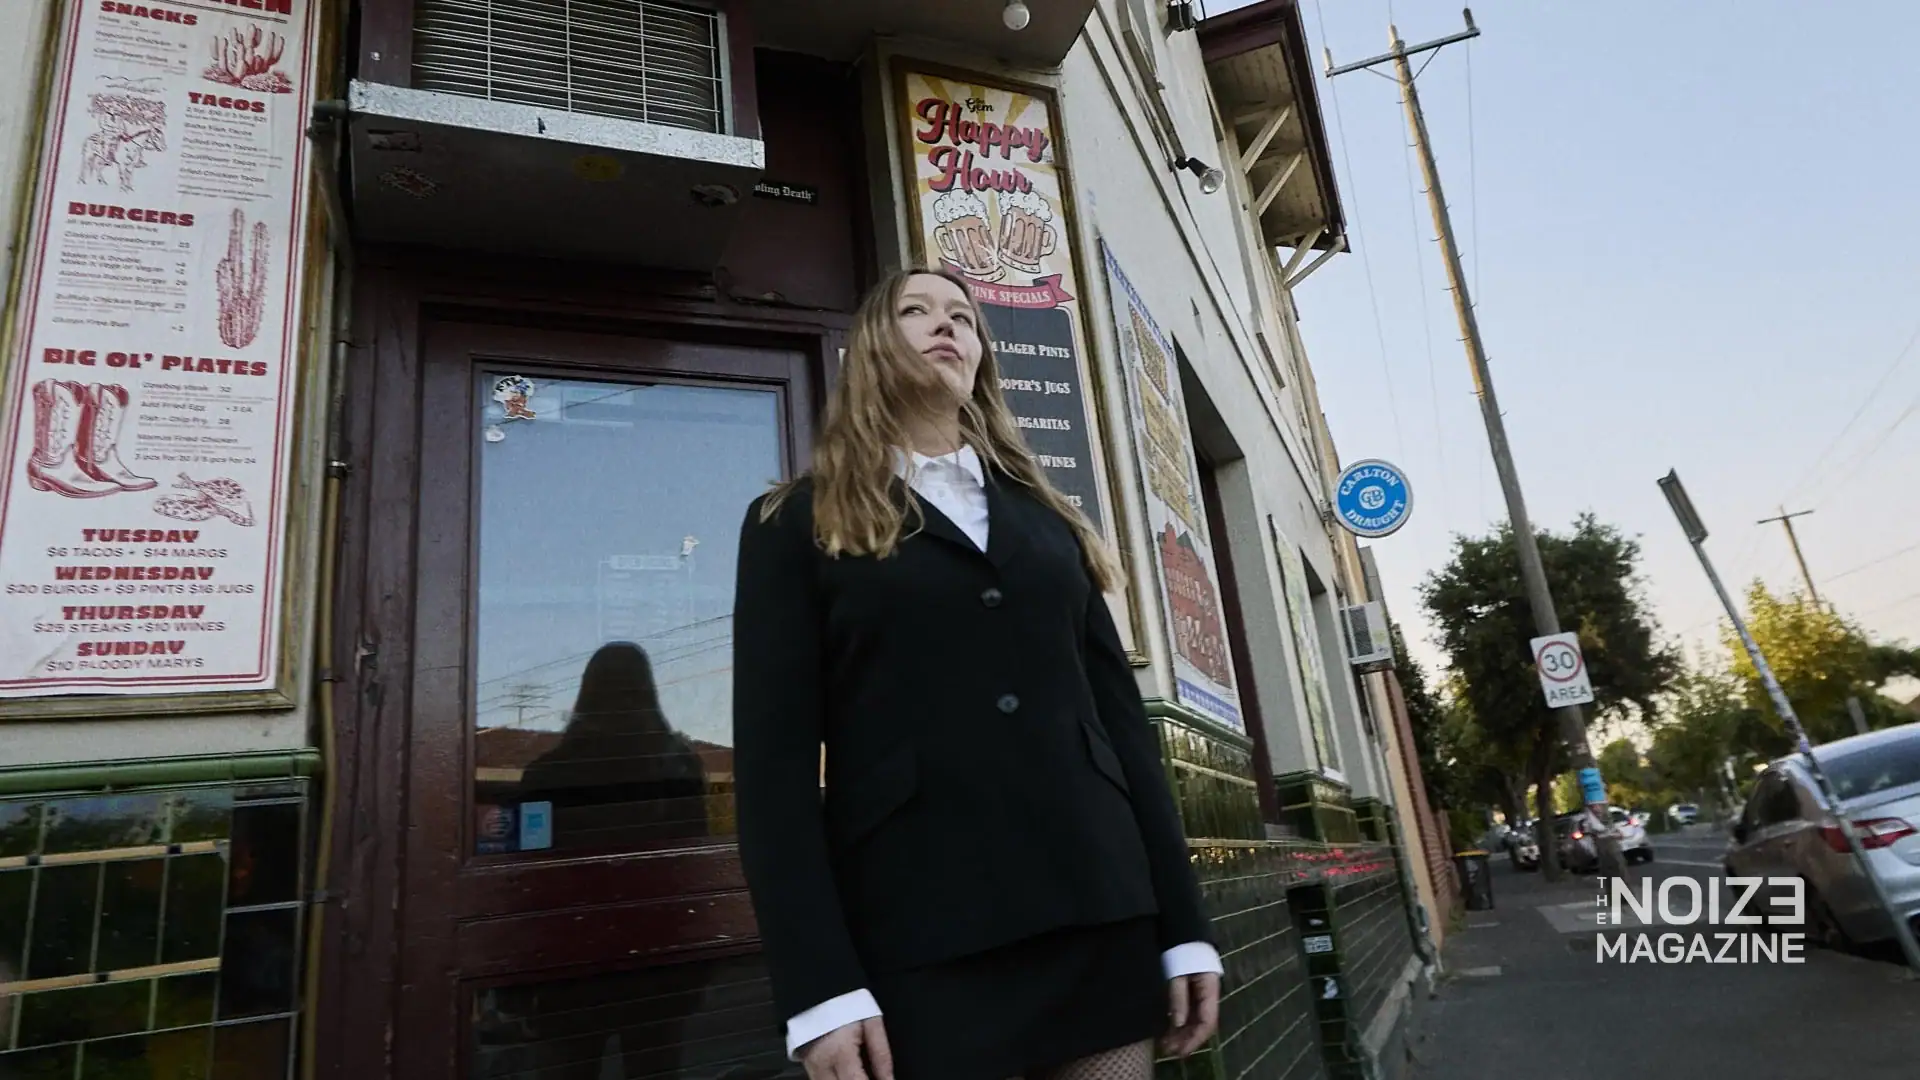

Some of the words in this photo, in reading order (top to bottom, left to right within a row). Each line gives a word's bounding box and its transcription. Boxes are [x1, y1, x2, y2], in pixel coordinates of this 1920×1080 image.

[101, 1, 197, 25] SNACKS
[187, 92, 266, 113] TACOS
[965, 97, 994, 113] Gem
[916, 98, 1049, 163] Happy
[928, 145, 1032, 194] Hour
[68, 201, 195, 227] BURGERS
[999, 290, 1051, 304] SPECIALS
[1000, 341, 1036, 355] LAGER
[1038, 344, 1071, 359] PINTS
[43, 348, 97, 367] BIG
[161, 355, 268, 377] PLATES
[1044, 380, 1071, 395] JUGS
[1039, 455, 1077, 468] WINES
[1340, 468, 1399, 496] CARLTON
[1345, 499, 1404, 527] DRAUGHT
[82, 528, 199, 543] TUESDAY
[72, 547, 124, 557] TACOS
[171, 548, 228, 558] MARGS
[55, 566, 215, 580] WEDNESDAY
[5, 584, 38, 594] $20
[42, 584, 99, 594] BURGS
[139, 584, 184, 594] PINTS
[216, 584, 255, 594] JUGS
[62, 605, 205, 620] THURSDAY
[69, 622, 132, 632] STEAKS
[175, 621, 226, 632] WINES
[76, 640, 186, 656] SUNDAY
[147, 657, 205, 668] MARYS
[1544, 651, 1575, 672] 30
[1549, 684, 1590, 702] AREA
